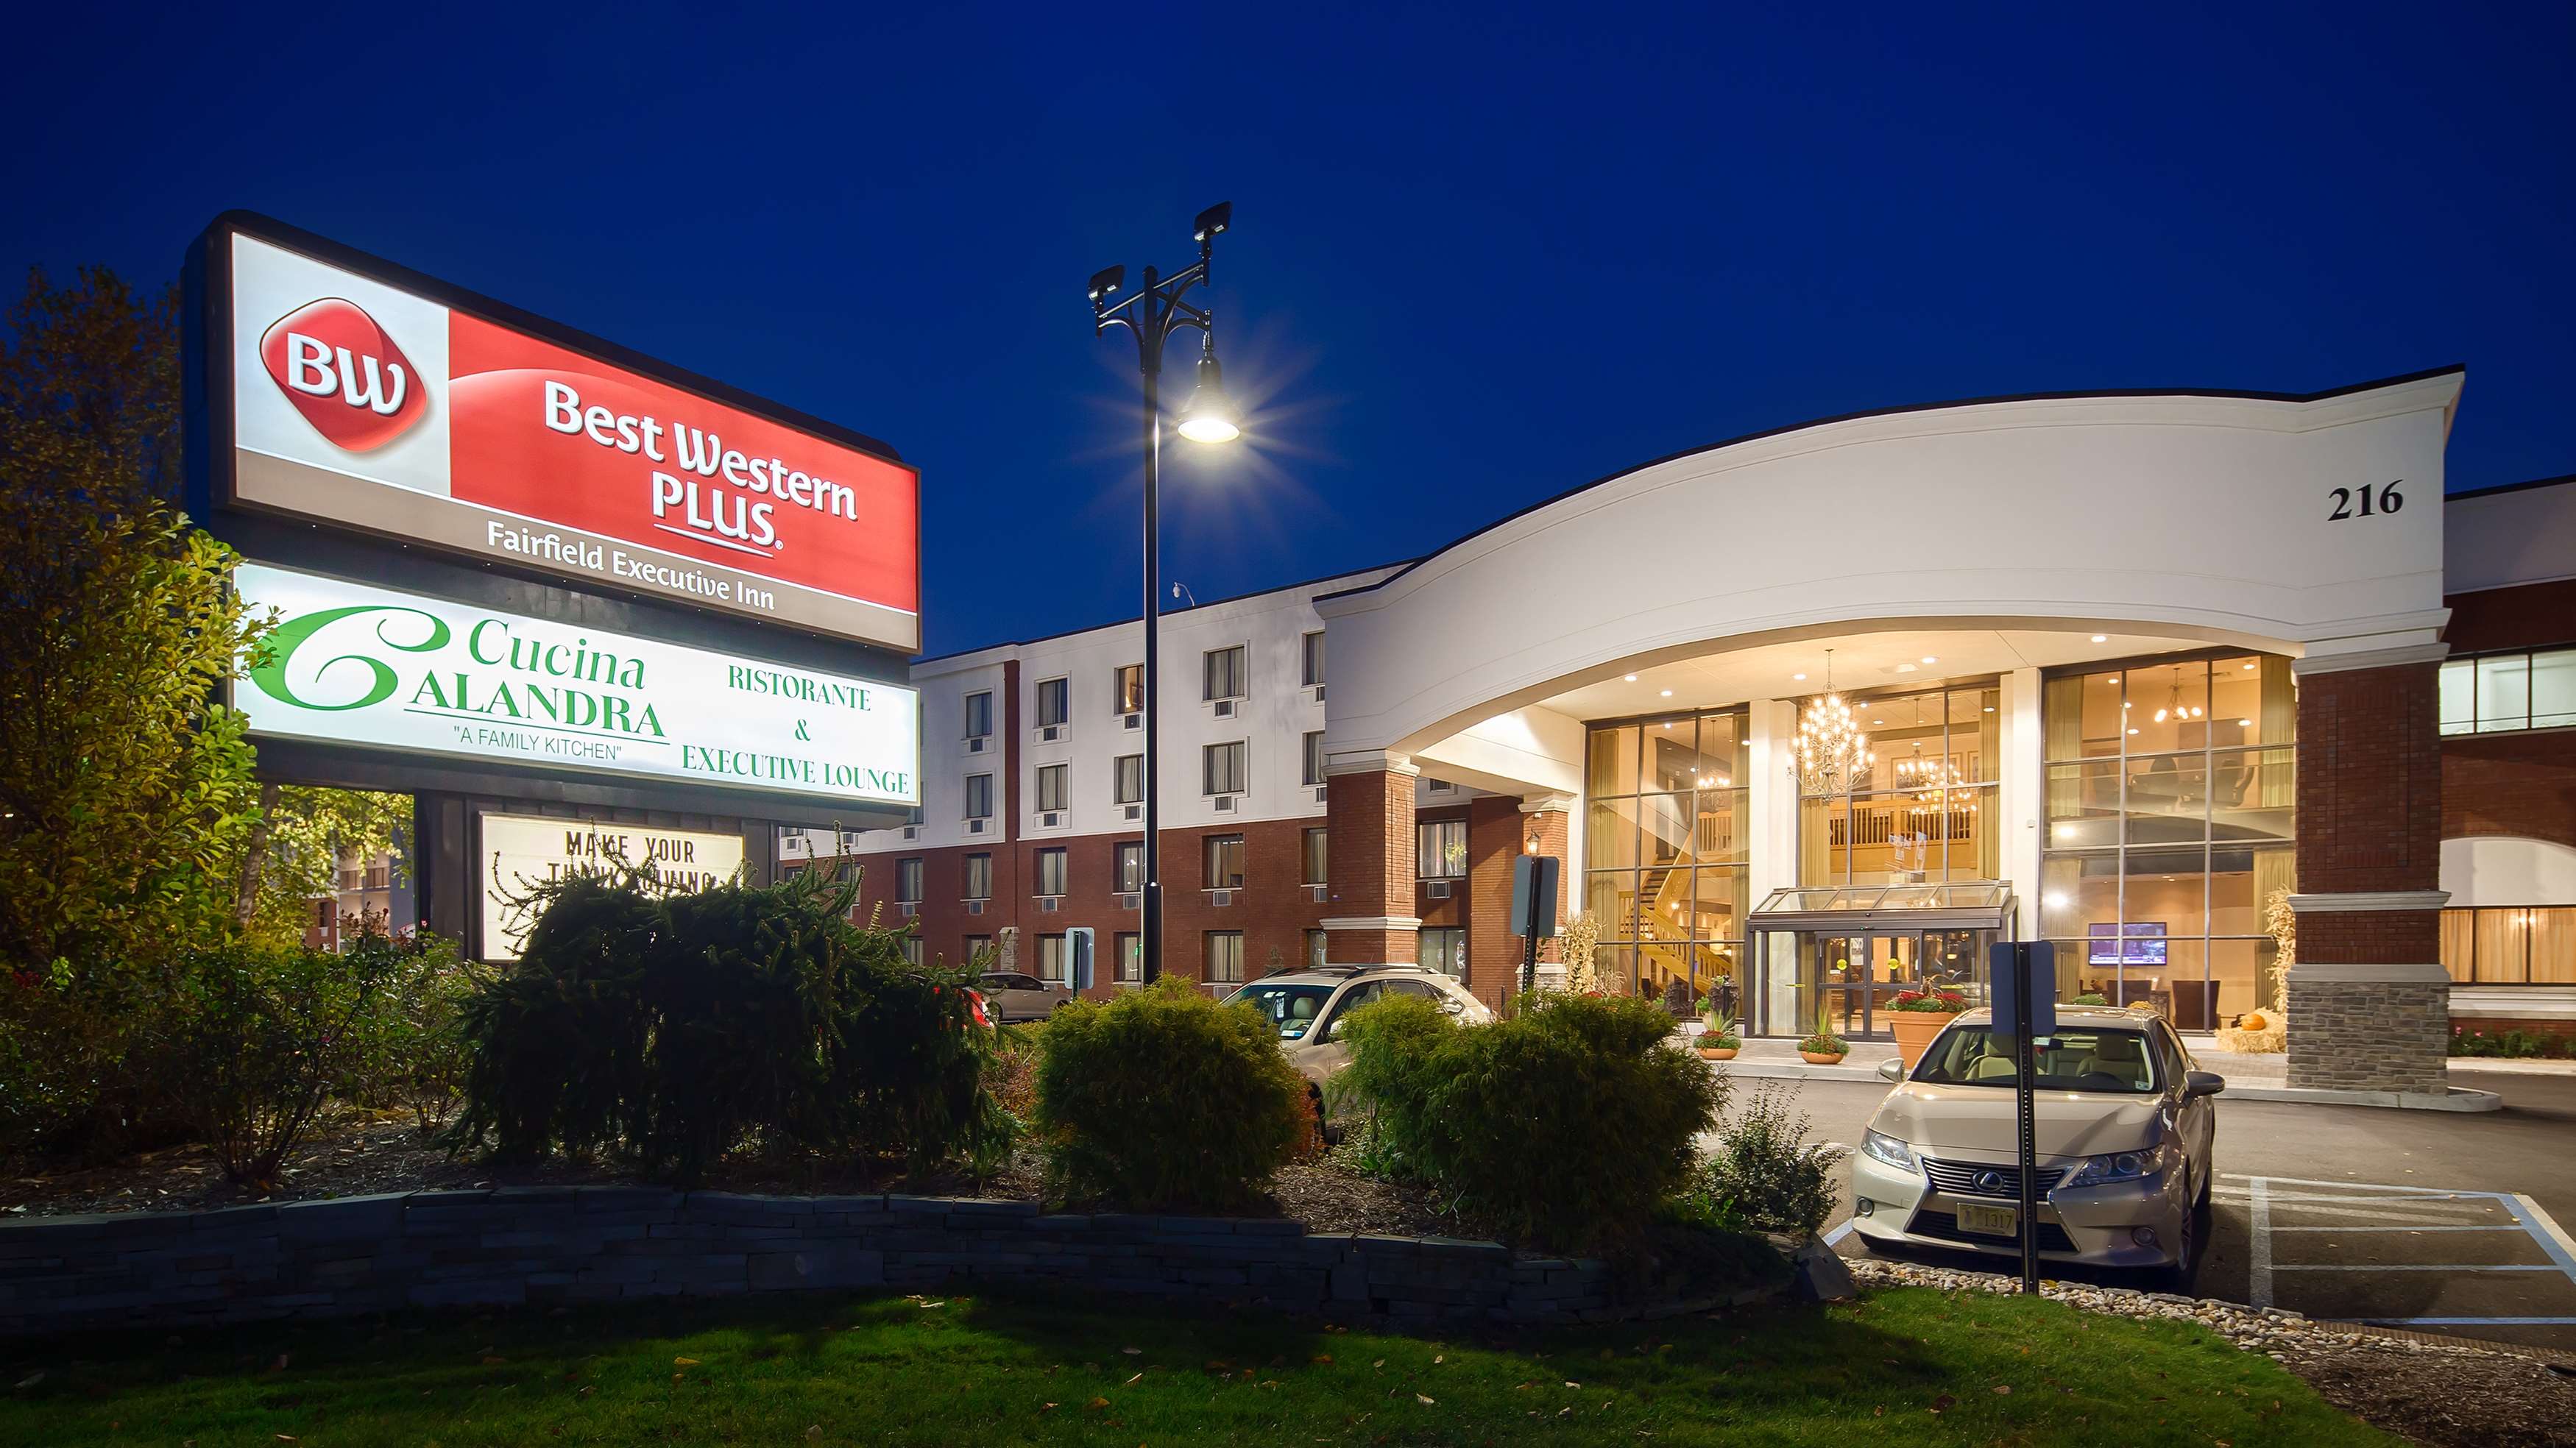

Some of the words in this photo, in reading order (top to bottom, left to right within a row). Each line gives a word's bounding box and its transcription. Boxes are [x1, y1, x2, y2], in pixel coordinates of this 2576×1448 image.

[287, 331, 406, 415] BW
[545, 380, 665, 462] Best
[673, 422, 857, 521] Western
[2327, 479, 2404, 522] 216
[486, 519, 604, 572] Fairfield
[612, 550, 731, 600] Executive
[737, 581, 775, 611] Inn
[469, 619, 646, 690] Cucina
[728, 664, 871, 711] RISTORANTE
[478, 728, 540, 751] FAMILY
[545, 736, 622, 761] KITCHEN"
[794, 718, 812, 742] &
[682, 744, 816, 784] EXECUTIVE
[824, 762, 910, 795] LOUNGE
[565, 830, 629, 860] MAKE
[645, 837, 695, 864] YOUR
